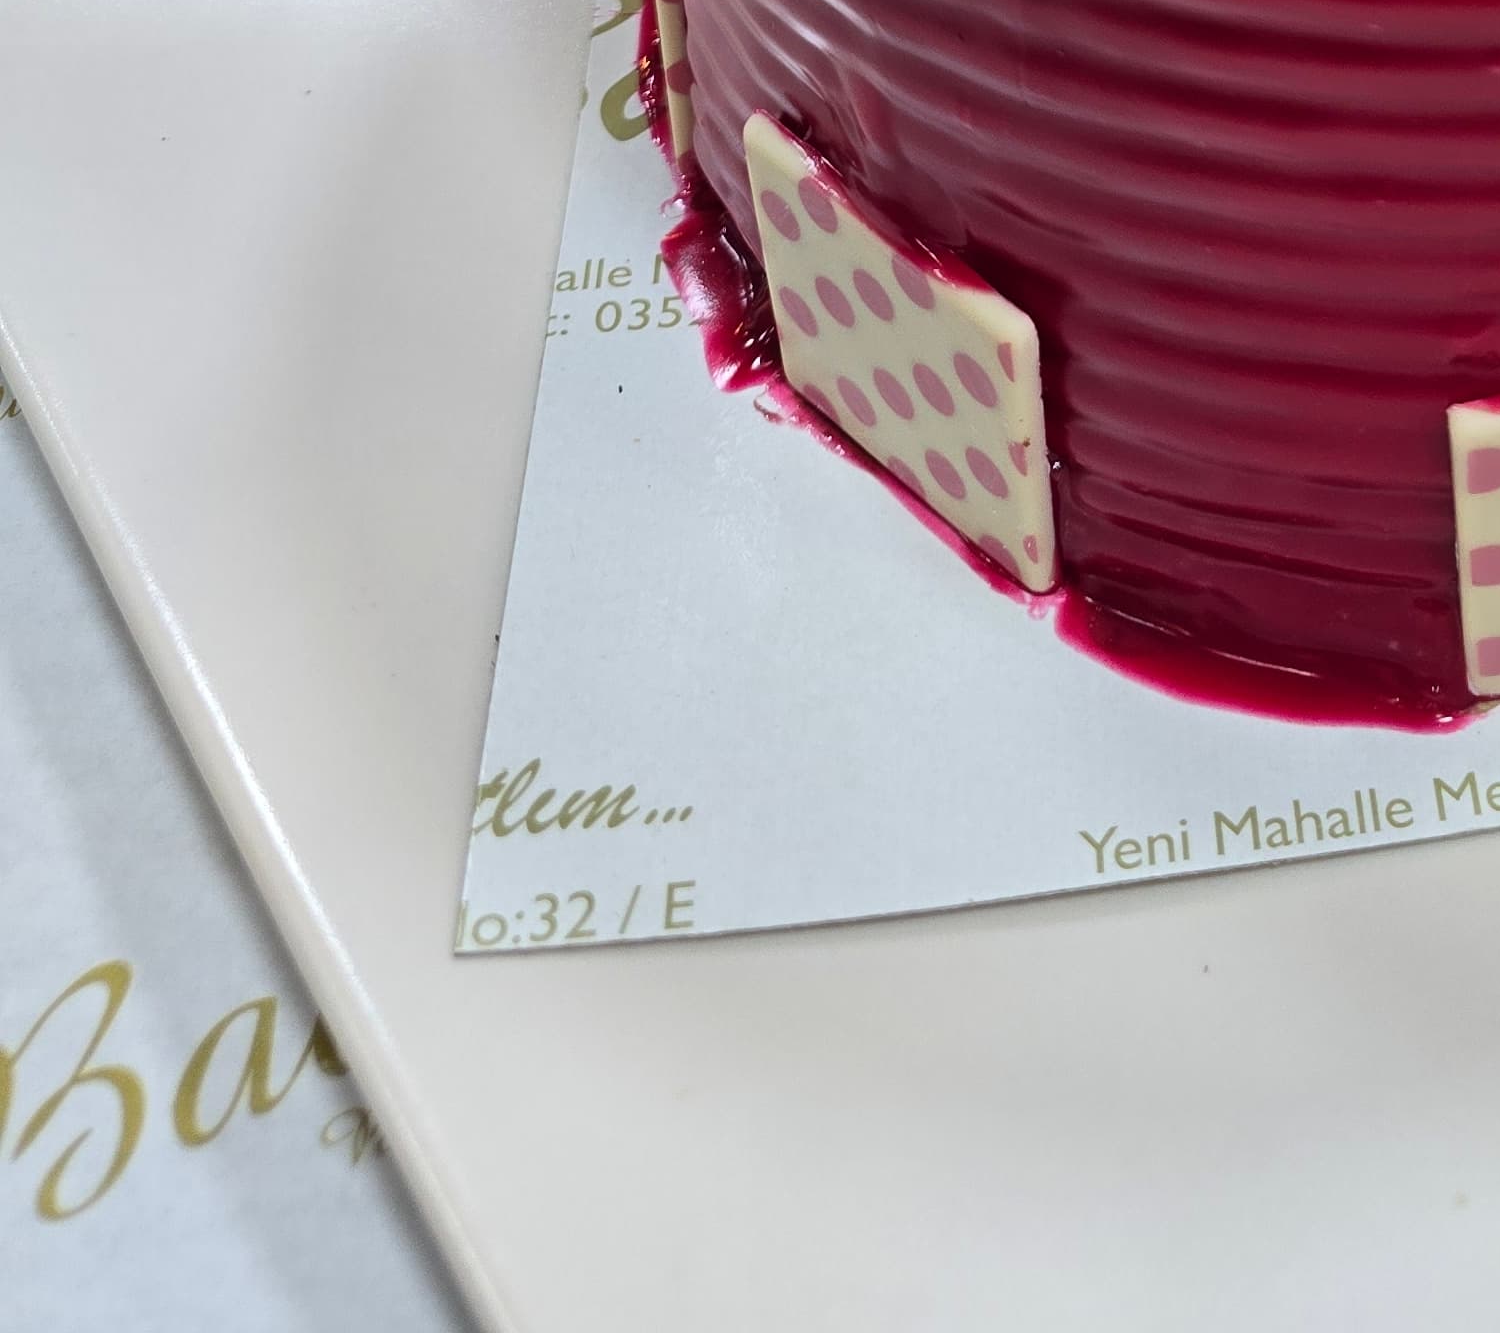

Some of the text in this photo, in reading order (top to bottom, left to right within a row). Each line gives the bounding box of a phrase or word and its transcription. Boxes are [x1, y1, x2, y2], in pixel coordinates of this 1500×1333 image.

[555, 258, 633, 292] alle
[594, 294, 706, 333] 035
[1079, 818, 1191, 874] Yeni
[1213, 788, 1414, 856] Mahalle
[664, 879, 696, 930] E
[0, 958, 348, 1223] Ba
